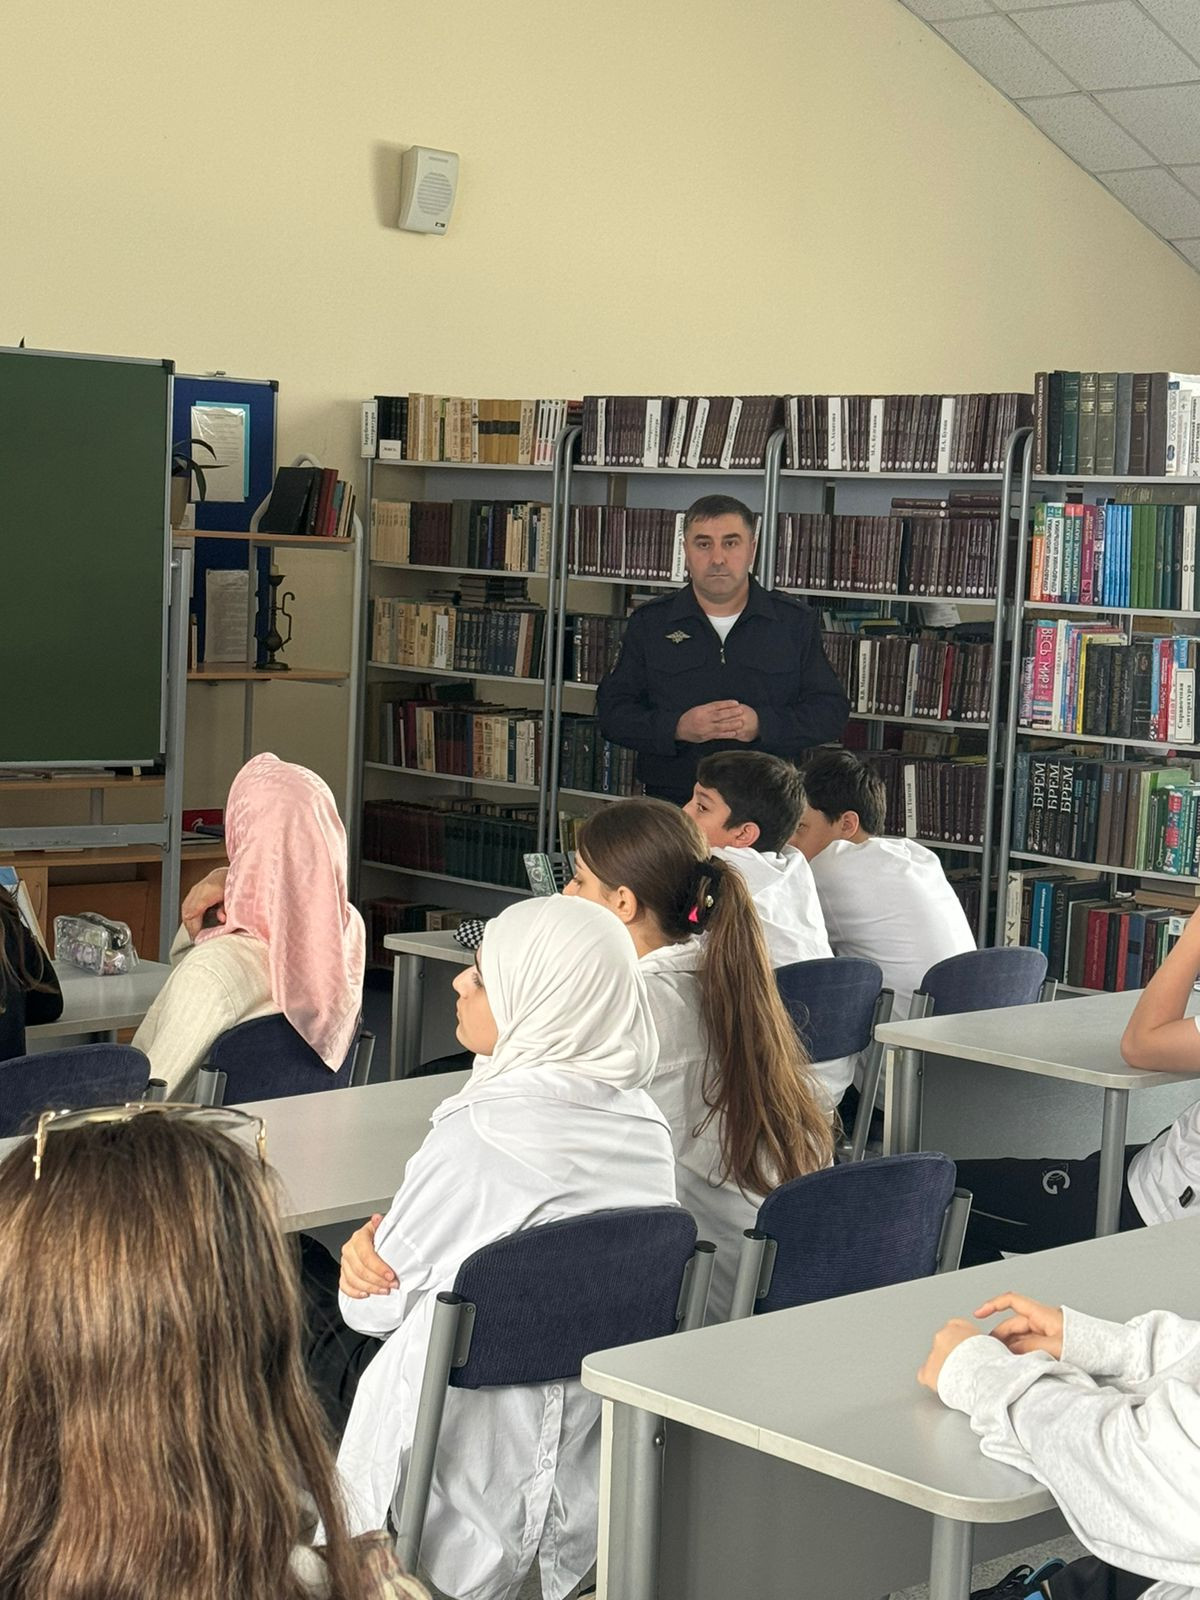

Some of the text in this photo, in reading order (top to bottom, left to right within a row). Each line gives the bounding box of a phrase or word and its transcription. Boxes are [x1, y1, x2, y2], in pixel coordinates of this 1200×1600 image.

[1063, 542, 1071, 592] ГУМАНИТАРНЫЕ
[1072, 542, 1080, 592] ГУМАНИТАРНЫЕ
[1038, 628, 1053, 683] ВЕСЬ МИР
[1032, 762, 1046, 808] БРЕМ
[1047, 764, 1060, 810] БРЕМ
[1060, 766, 1074, 813] БРЕМ
